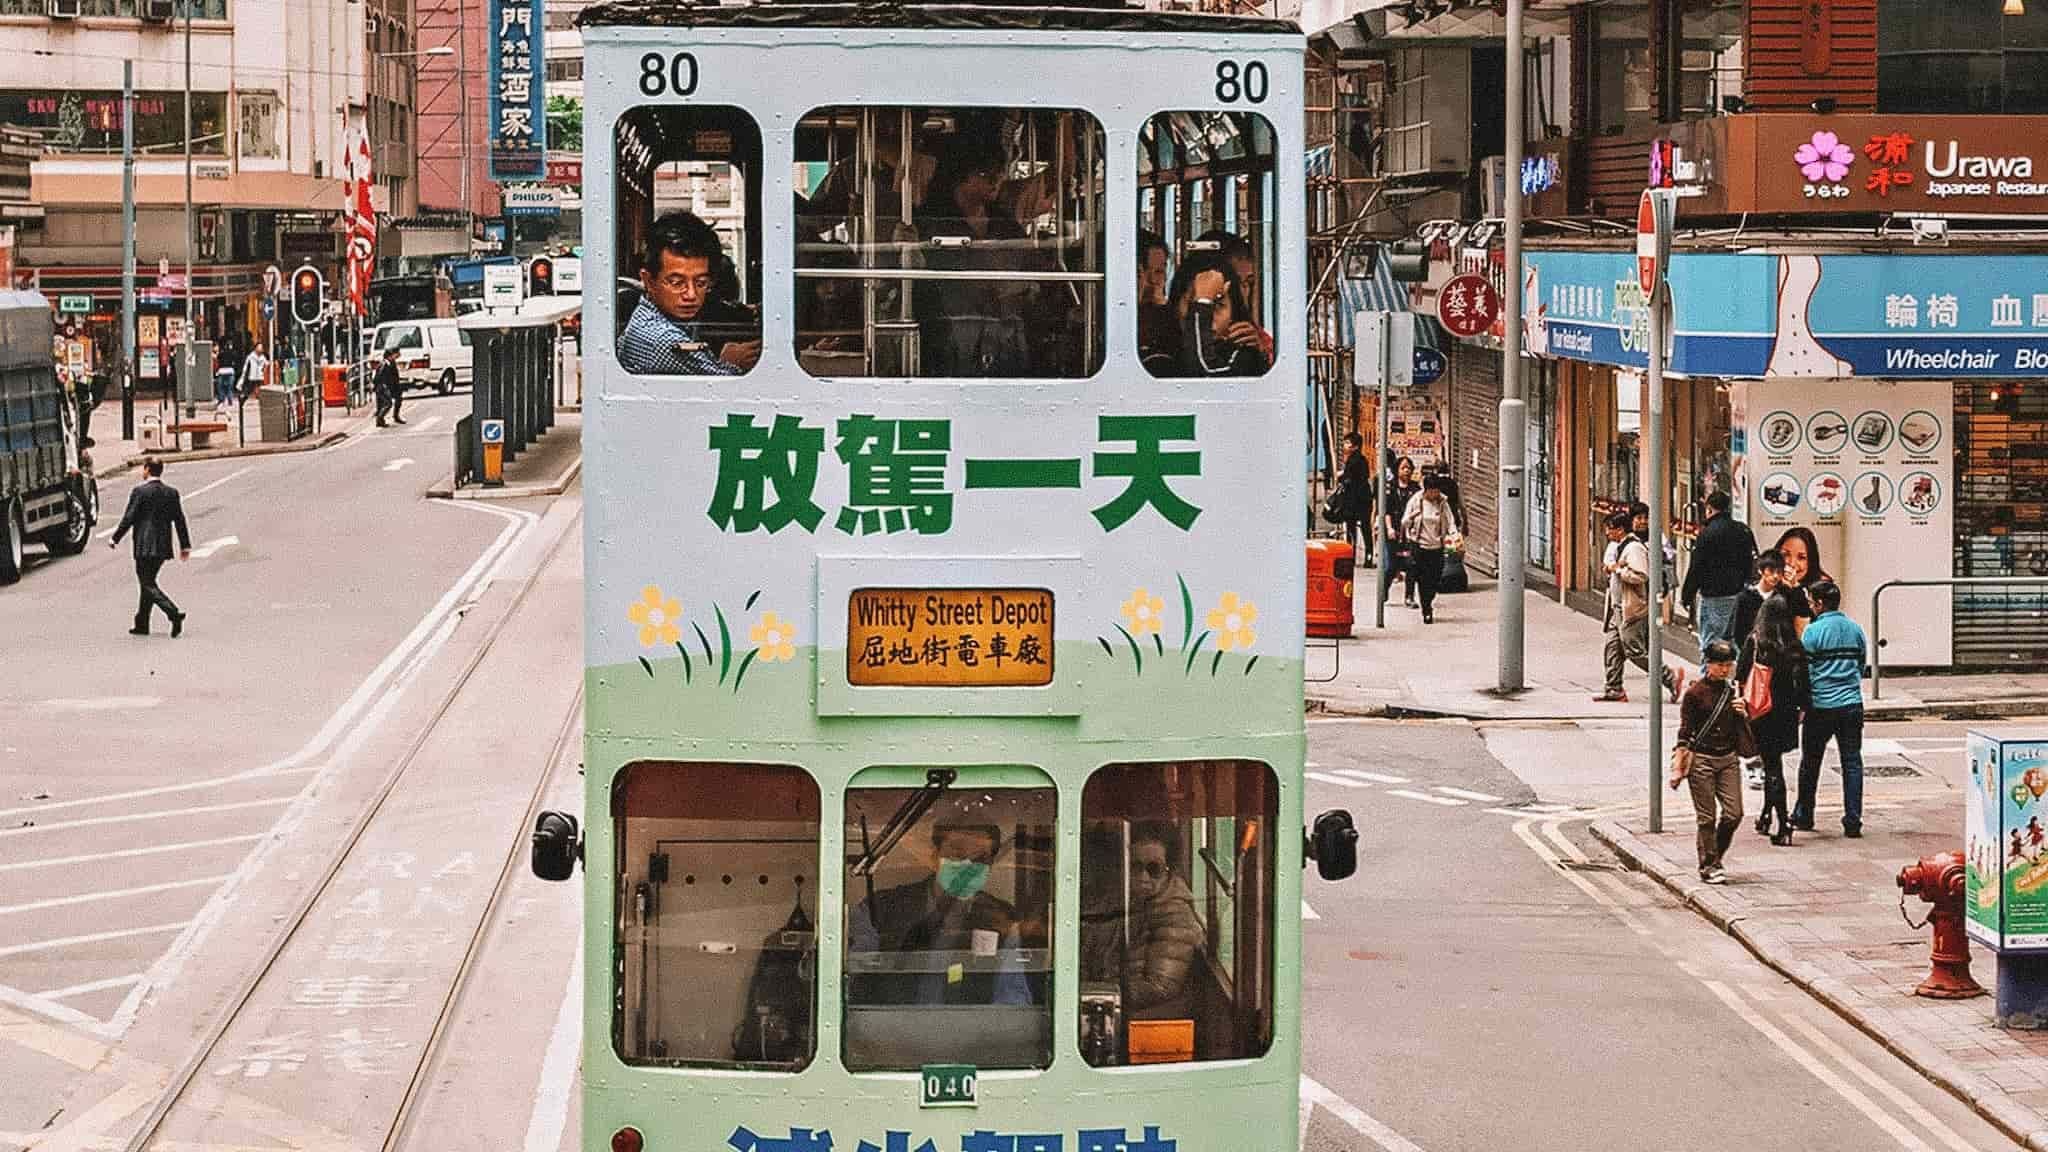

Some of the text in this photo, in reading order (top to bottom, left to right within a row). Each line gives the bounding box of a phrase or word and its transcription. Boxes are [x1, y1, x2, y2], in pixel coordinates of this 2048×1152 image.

[639, 52, 699, 96] 80
[1215, 60, 1268, 104] 80
[1925, 140, 2032, 177] Urawa
[512, 192, 554, 201] PHILIPS
[1803, 185, 1850, 197] うらわ
[1926, 181, 1991, 197] Japanese
[1885, 293, 1959, 328] 輪椅
[1886, 349, 2048, 369] Wheelchair Blo
[706, 412, 1204, 535] 放駕一天
[857, 595, 1048, 632] Whitty Street Depot
[857, 631, 1048, 668] 屈地街電車廠
[928, 1075, 974, 1097] 040
